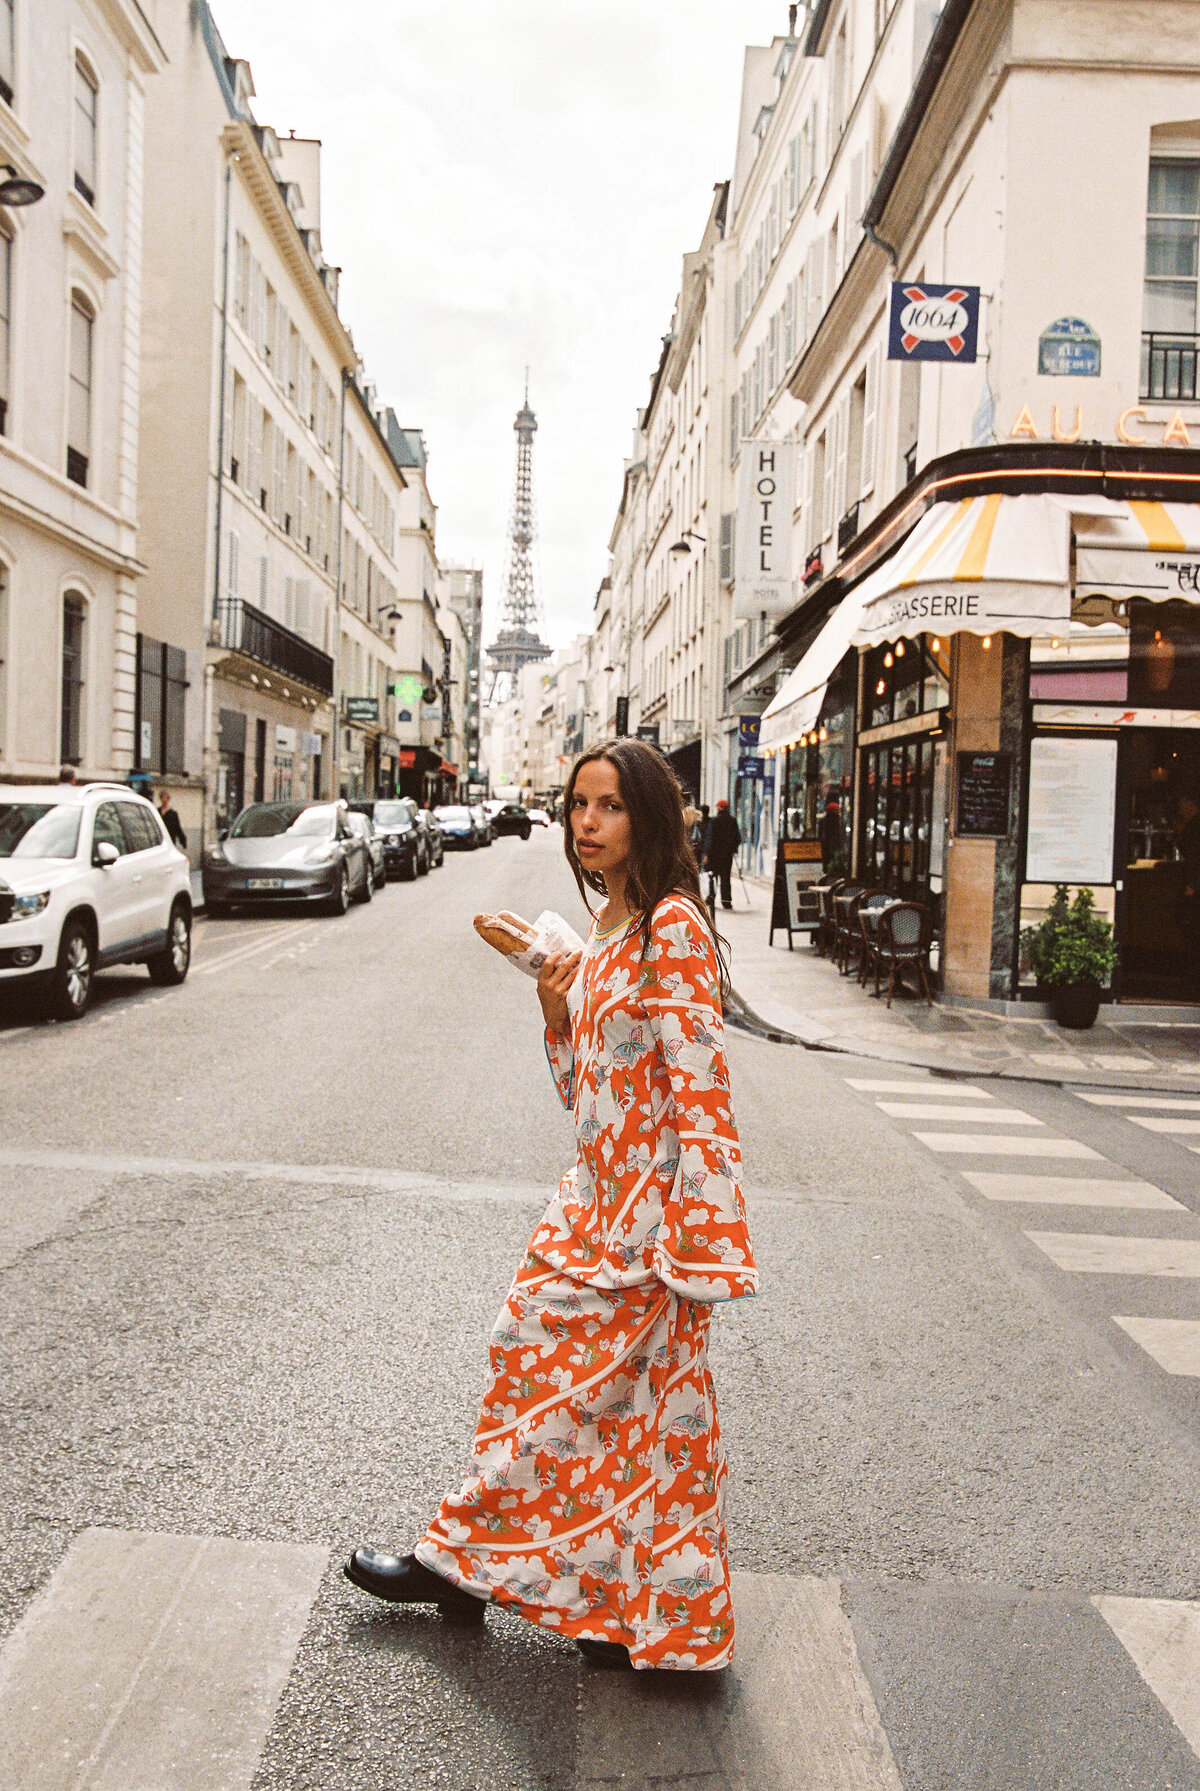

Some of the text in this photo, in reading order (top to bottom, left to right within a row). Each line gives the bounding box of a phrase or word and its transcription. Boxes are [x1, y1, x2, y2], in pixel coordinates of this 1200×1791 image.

[908, 303, 958, 330] 1664
[1010, 403, 1083, 443] AU
[757, 451, 776, 571] HOTEL
[890, 595, 980, 621] ASSERIE
